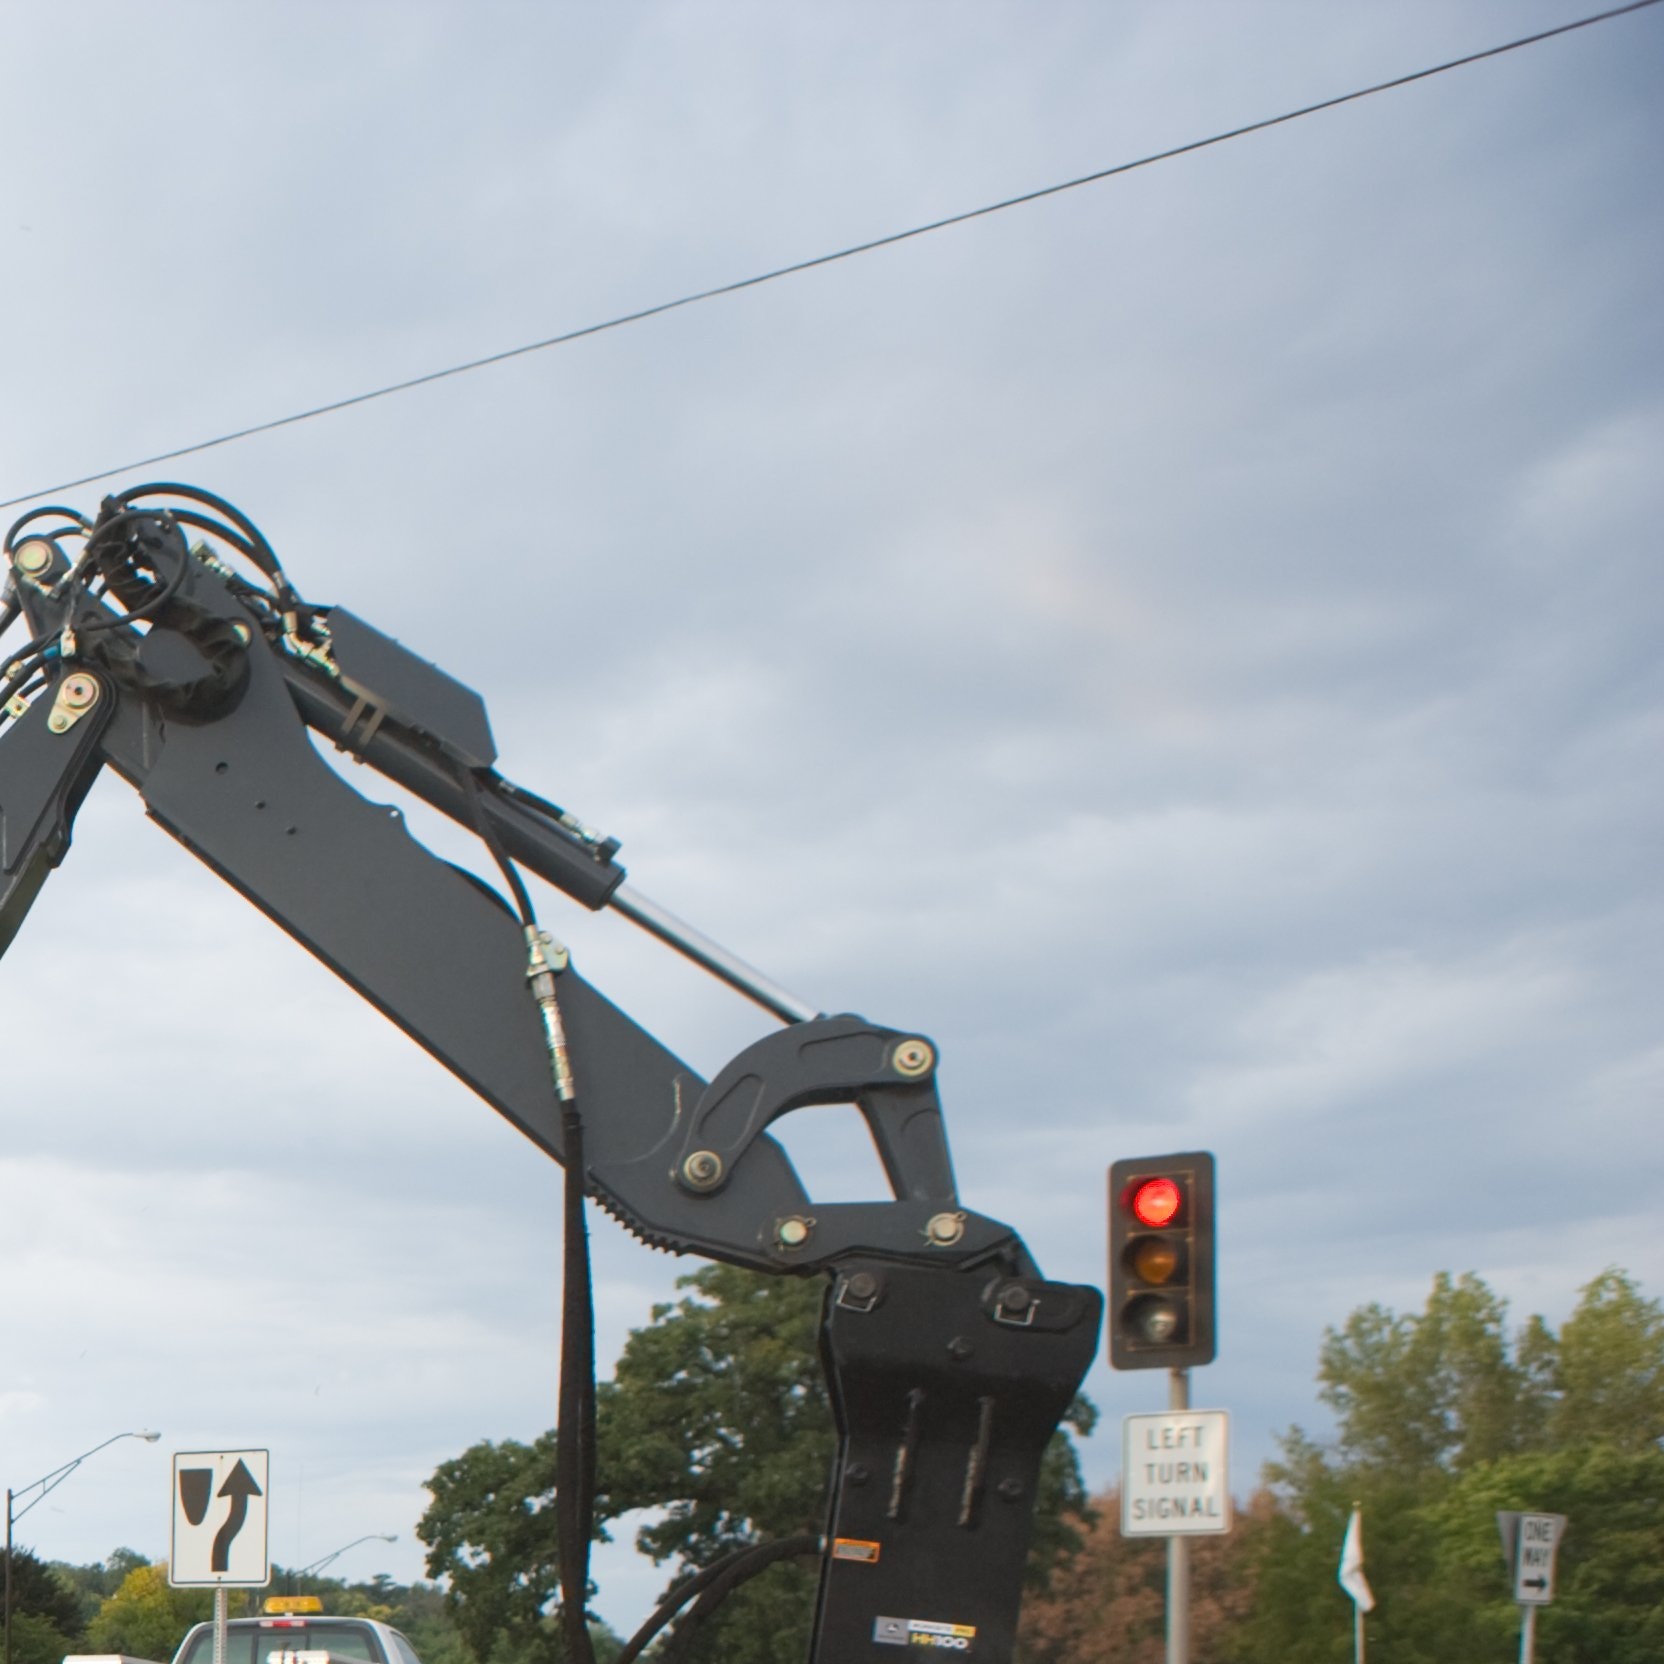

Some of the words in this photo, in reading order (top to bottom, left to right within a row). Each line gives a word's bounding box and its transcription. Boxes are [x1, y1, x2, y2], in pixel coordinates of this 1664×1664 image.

[1146, 1426, 1205, 1450] LEFT
[1144, 1461, 1209, 1485] TURN
[1132, 1496, 1221, 1520] SIGNAL
[1524, 1520, 1553, 1542] ONE
[1523, 1546, 1550, 1568] WAY
